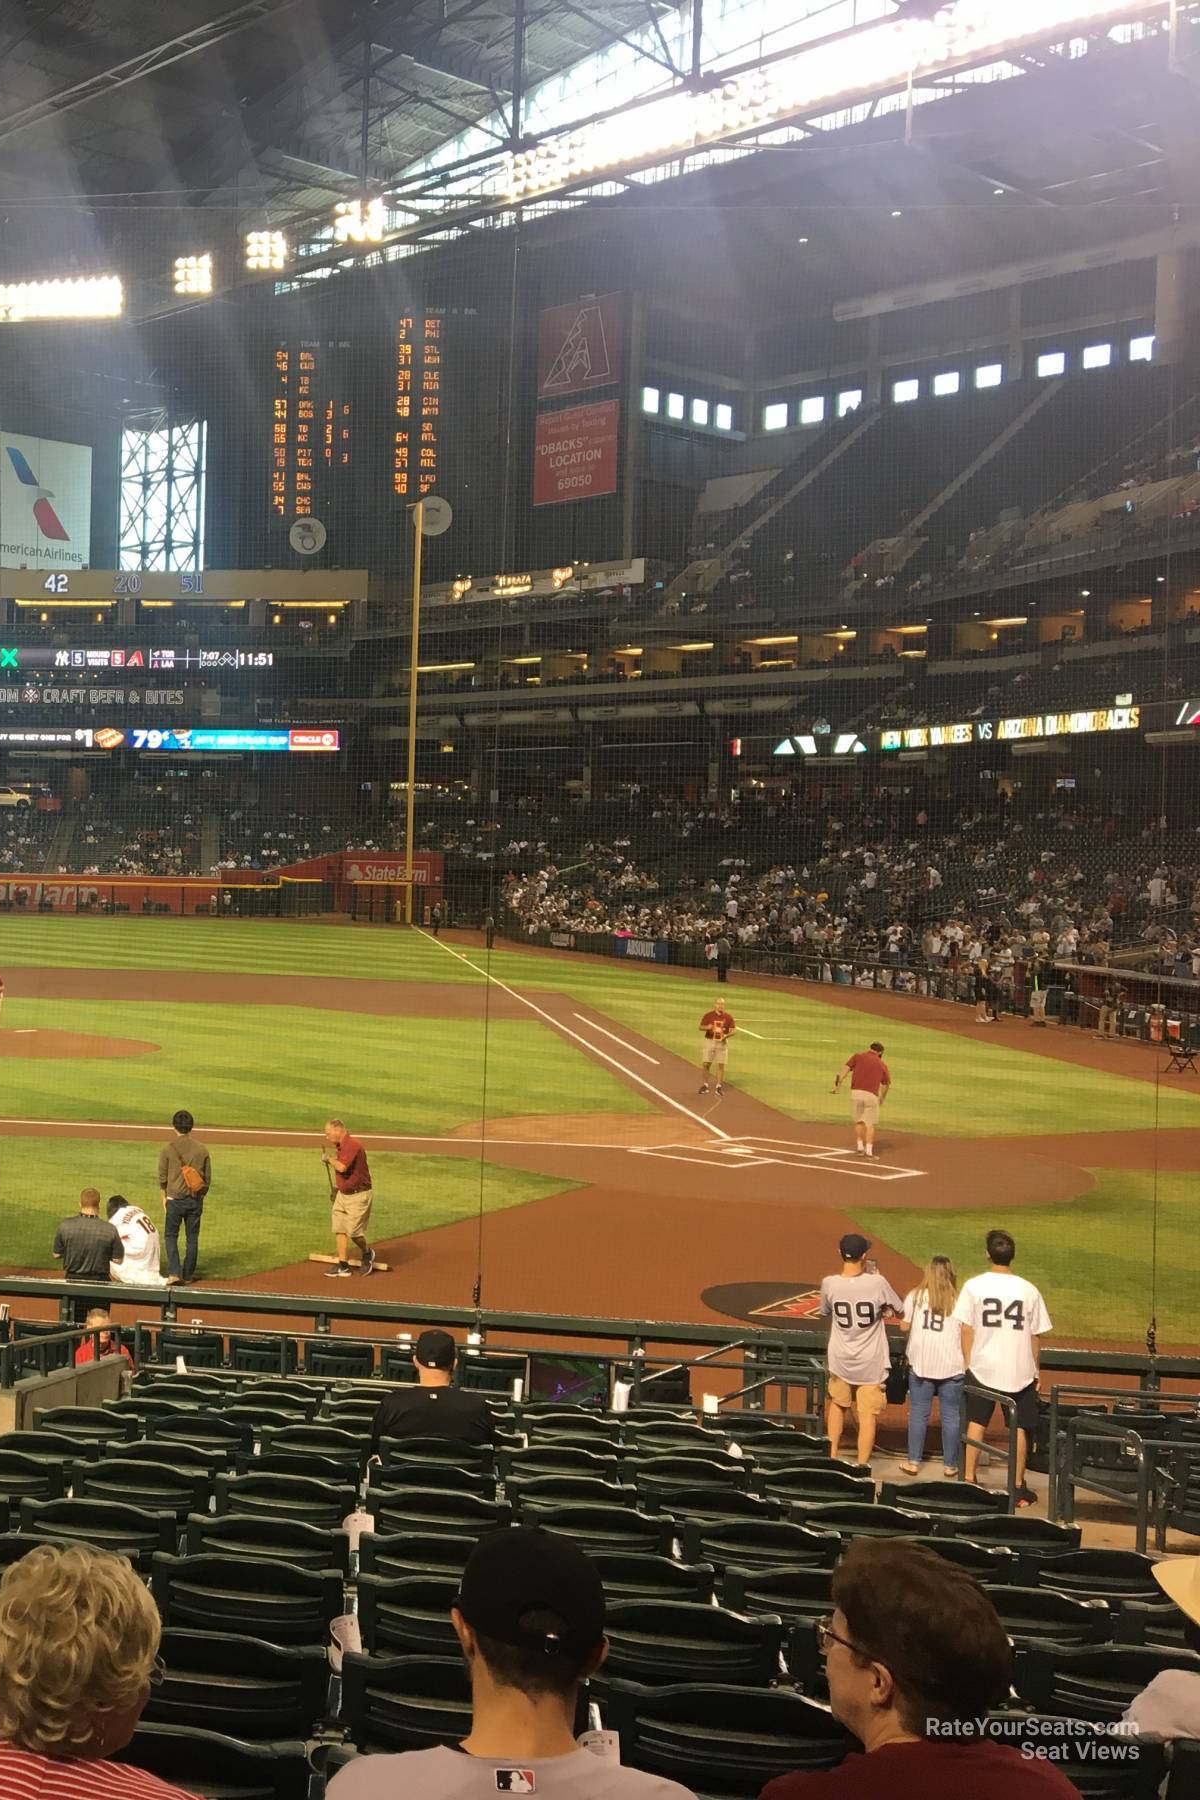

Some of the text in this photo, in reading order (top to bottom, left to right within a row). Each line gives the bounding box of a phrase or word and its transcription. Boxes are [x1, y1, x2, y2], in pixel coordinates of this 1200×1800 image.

[550, 448, 602, 468] LOCATION
[558, 474, 592, 490] 69050
[44, 546, 83, 563] Airlines
[44, 574, 204, 594] 42 20 51
[161, 650, 175, 658] TOR
[202, 652, 219, 660] 7:07
[240, 653, 273, 666] 11:51
[161, 660, 174, 668] LAA
[43, 689, 86, 704] CRAFT
[145, 690, 184, 704] BITES
[880, 708, 1140, 750] NEW YORK YANKEES VS ARIZONA DIAMONDBACKS
[74, 729, 94, 748] $1
[293, 736, 322, 744] CIRCLE
[136, 1216, 156, 1234] 18
[834, 1301, 875, 1328] 99
[922, 1309, 944, 1332] 18
[982, 1298, 1025, 1330] 24
